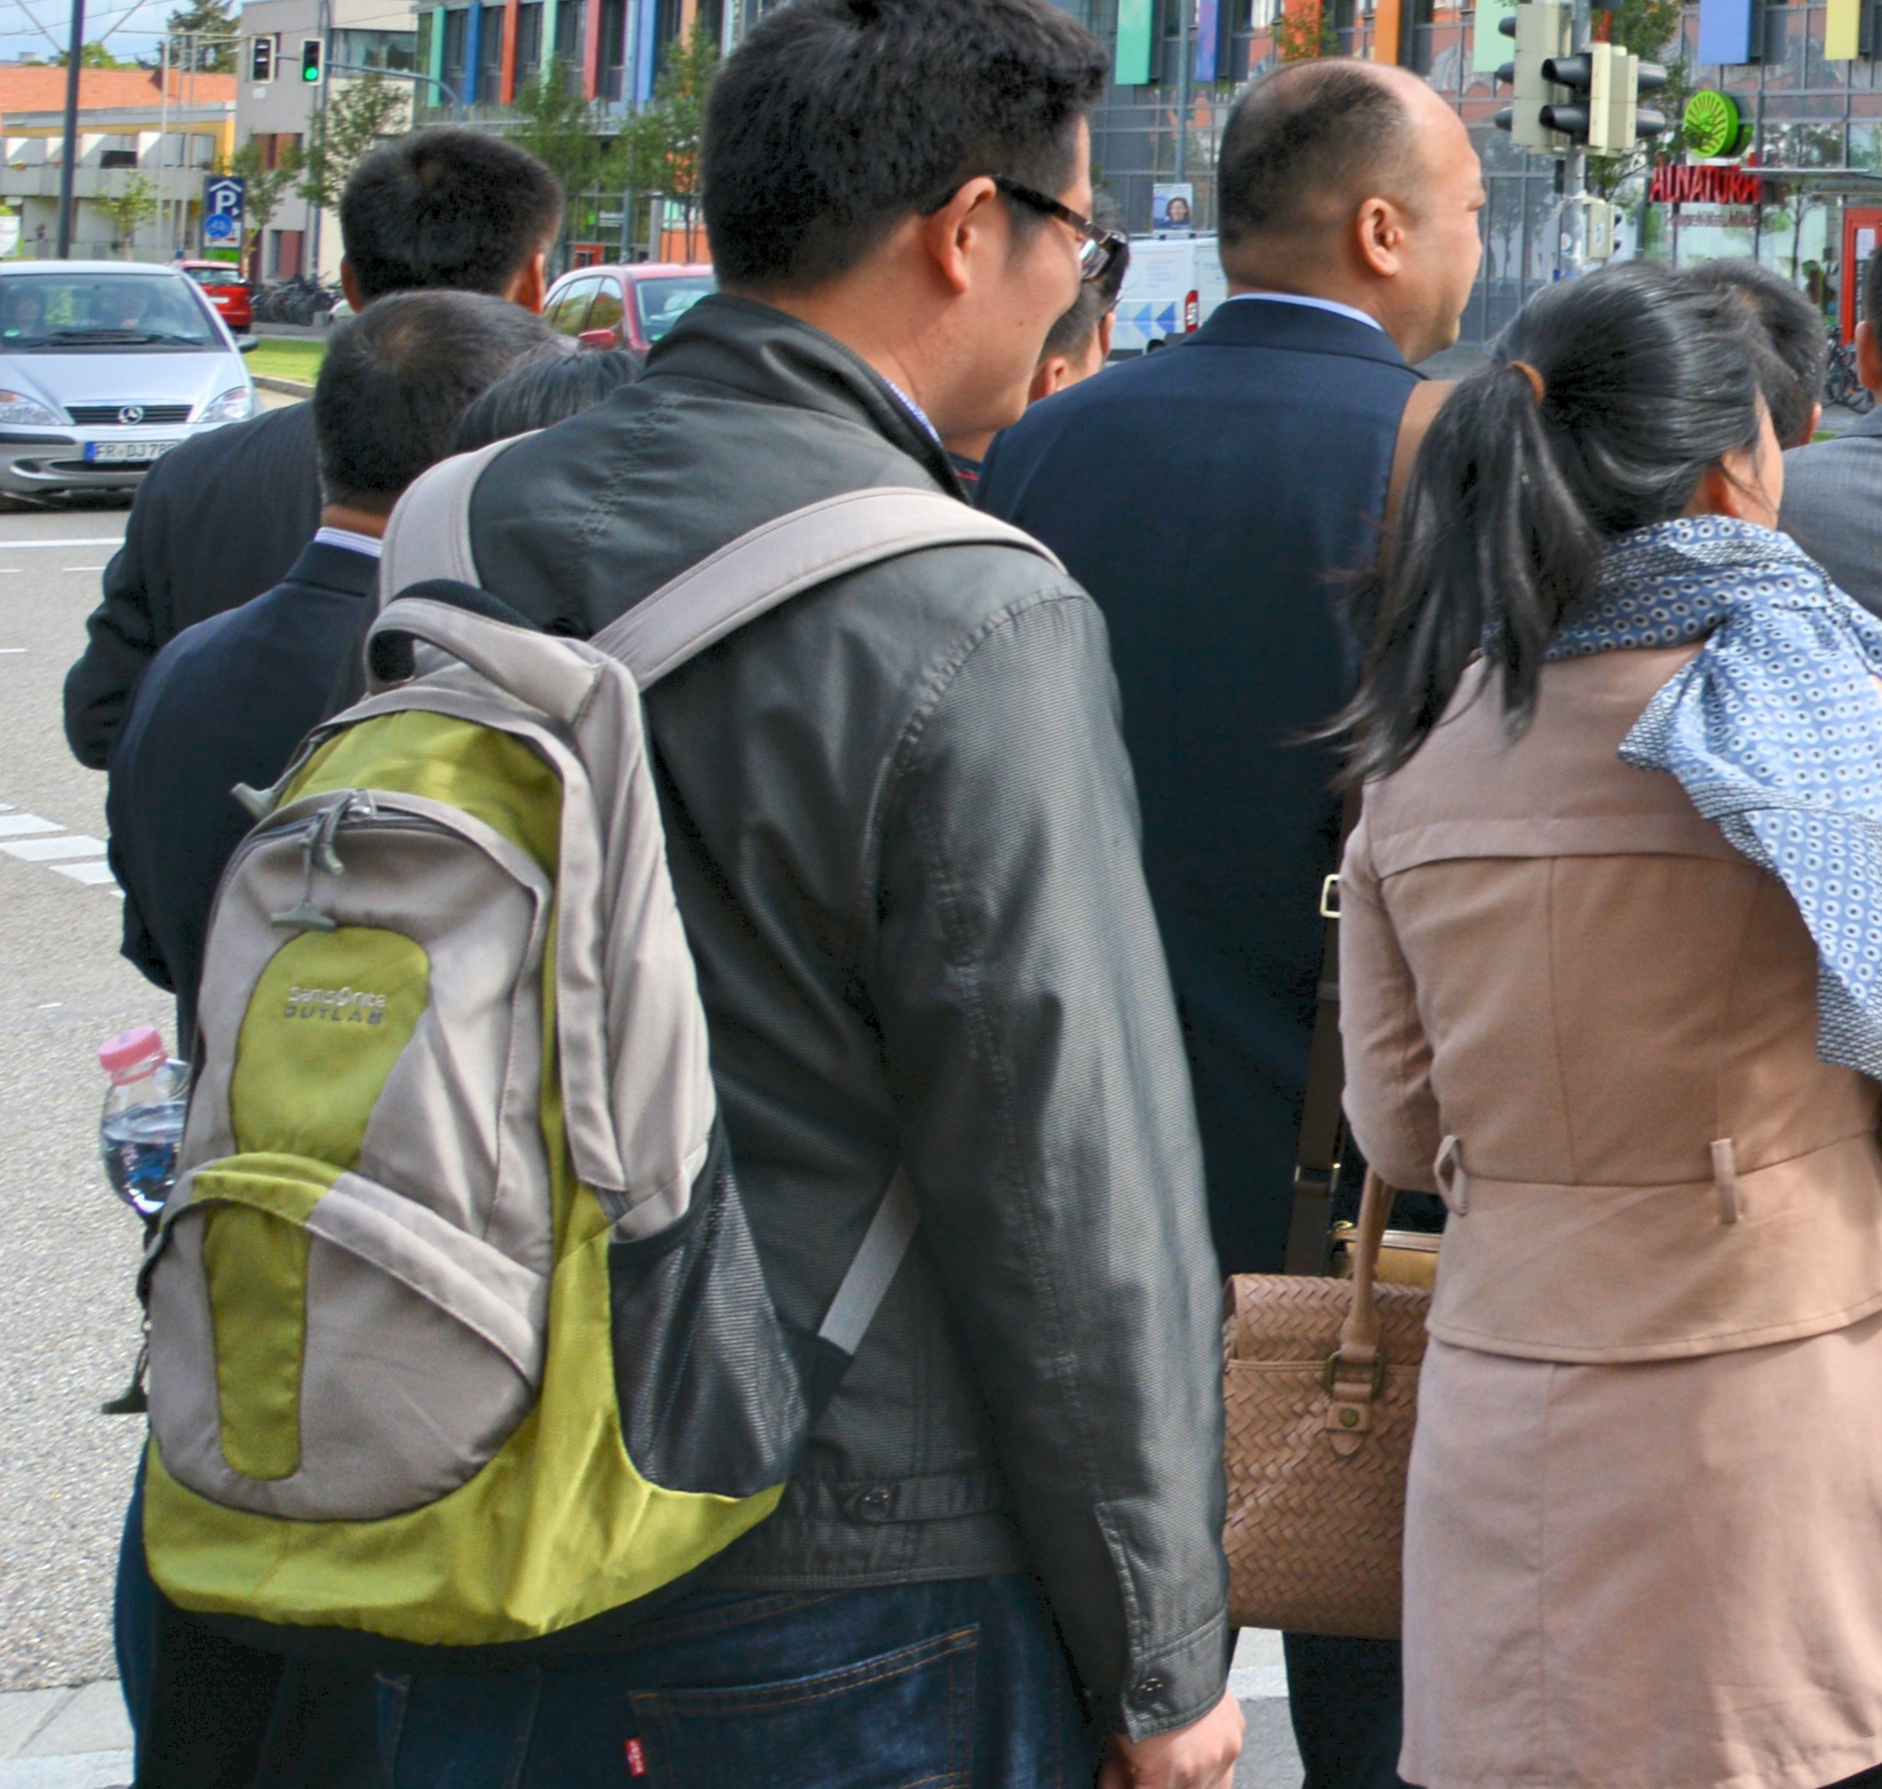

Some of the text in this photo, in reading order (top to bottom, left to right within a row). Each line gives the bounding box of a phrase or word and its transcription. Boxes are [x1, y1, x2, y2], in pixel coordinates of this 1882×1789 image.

[1648, 164, 1760, 204] ALNATURA
[216, 190, 237, 215] P
[96, 444, 116, 457] FR
